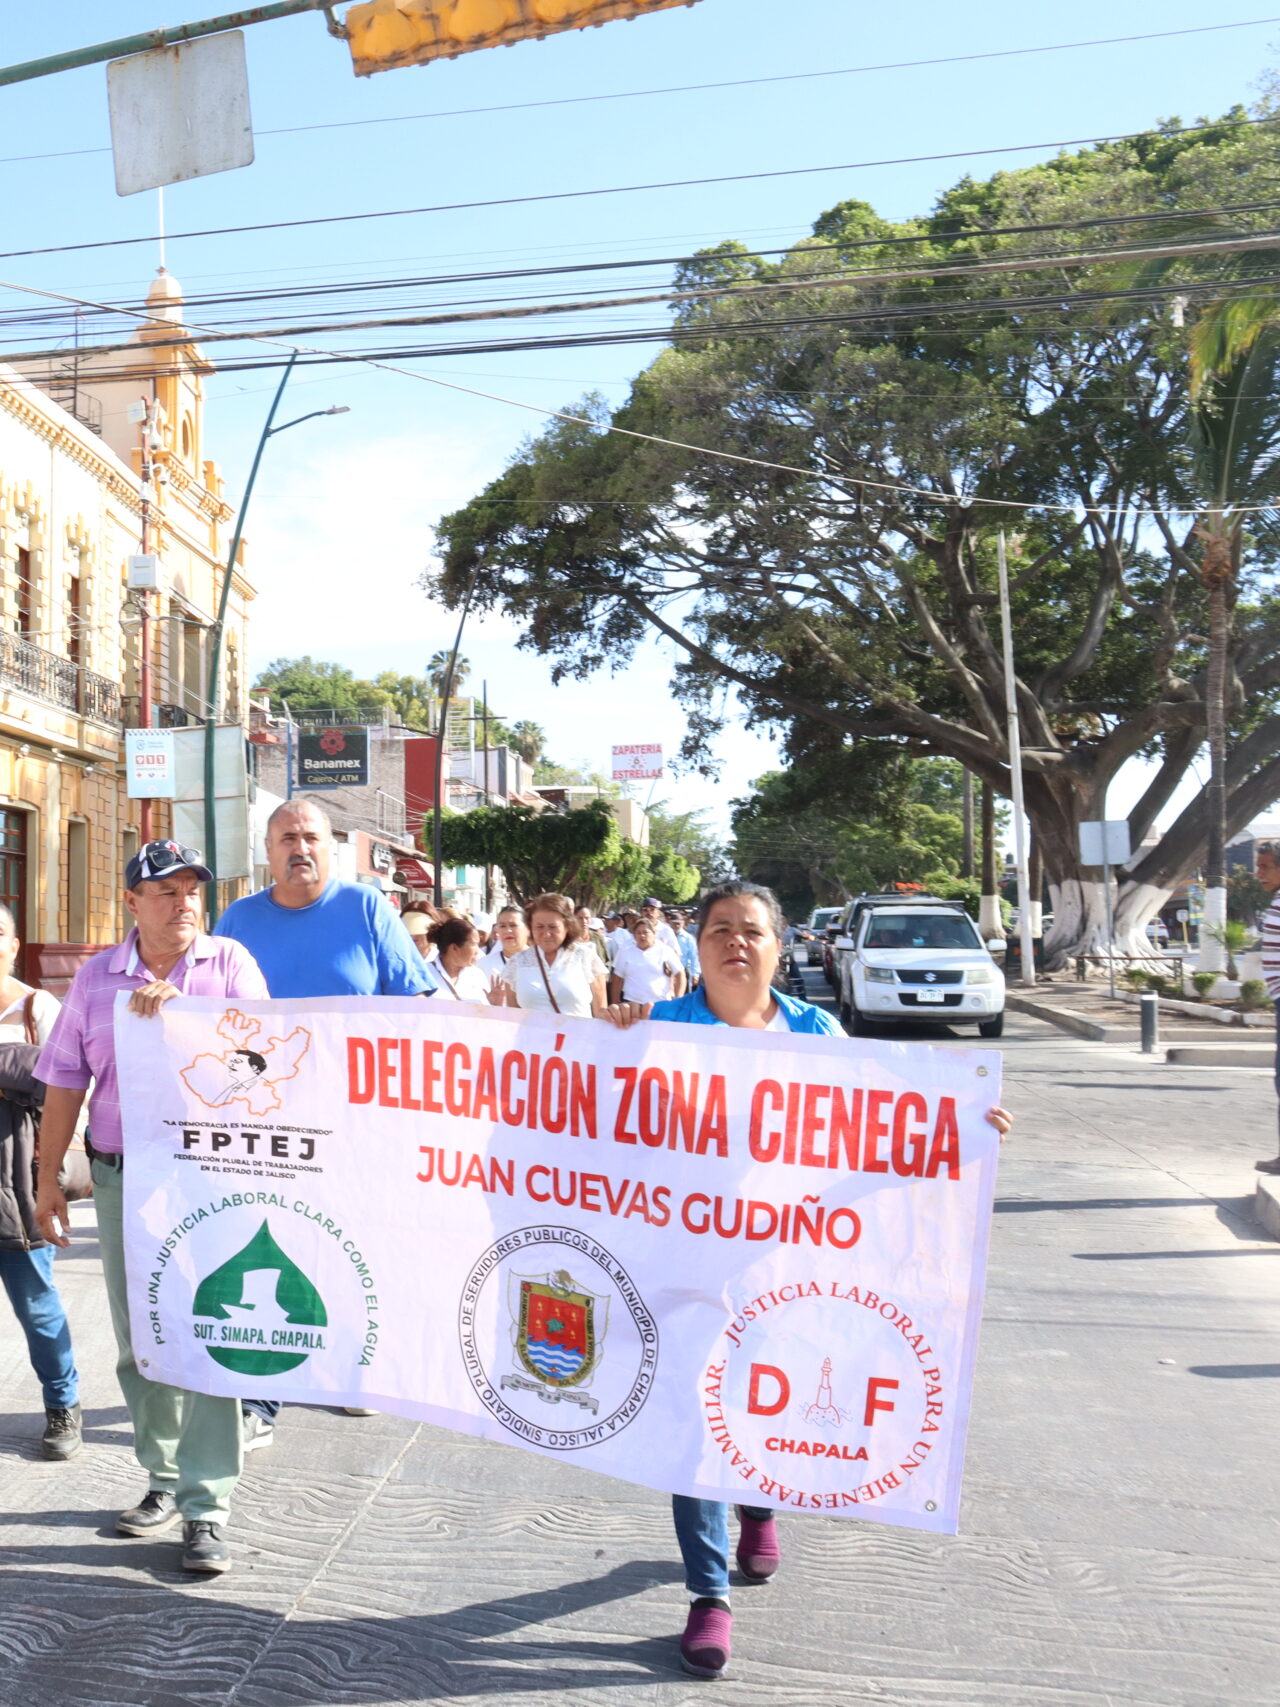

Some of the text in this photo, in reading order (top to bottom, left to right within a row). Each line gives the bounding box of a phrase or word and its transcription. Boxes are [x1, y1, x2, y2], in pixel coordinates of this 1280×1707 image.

[612, 744, 662, 755] ZAPATERIA
[303, 758, 361, 769] Banamex
[612, 769, 663, 779] ESTRELLAS
[307, 775, 334, 784] Cajero
[346, 1033, 961, 1181] DELEGACIÓN ZONA CIENEGA
[178, 1120, 228, 1129] DEMOCRACIA
[241, 1123, 274, 1131] MANDAR
[183, 1130, 315, 1160] FPTEJ
[174, 1153, 220, 1163] FEDERACIÓN
[222, 1158, 250, 1166] PLURAL
[264, 1161, 323, 1173] TRABAJADORES
[223, 1166, 252, 1175] ESTADO
[265, 1170, 296, 1179] JALISCO
[416, 1146, 862, 1250] JUAN CUEVAS GUDIÑO
[524, 1229, 589, 1251] PUBLICOS
[465, 1235, 522, 1303] SERVIDORES
[590, 1248, 613, 1271] DEL
[149, 1191, 379, 1366] POR UNA JUSTICIA LABORAL CLARA COMO EL AGUA
[462, 1307, 473, 1326] DE
[613, 1270, 656, 1343] MUNICIPIO
[193, 1323, 326, 1350] SUT. SIMAPA. CHAPALA.
[464, 1333, 486, 1387] PLURAL
[643, 1348, 656, 1369] DE
[606, 1371, 650, 1431] CHAPALA
[704, 1281, 944, 1510] JUSTICIA LABORAL PARA UN BIENESTAR FAMILIAR.
[747, 1362, 900, 1427] D F
[483, 1388, 542, 1442] SINDICATO
[765, 1436, 869, 1461] CHAPALA
